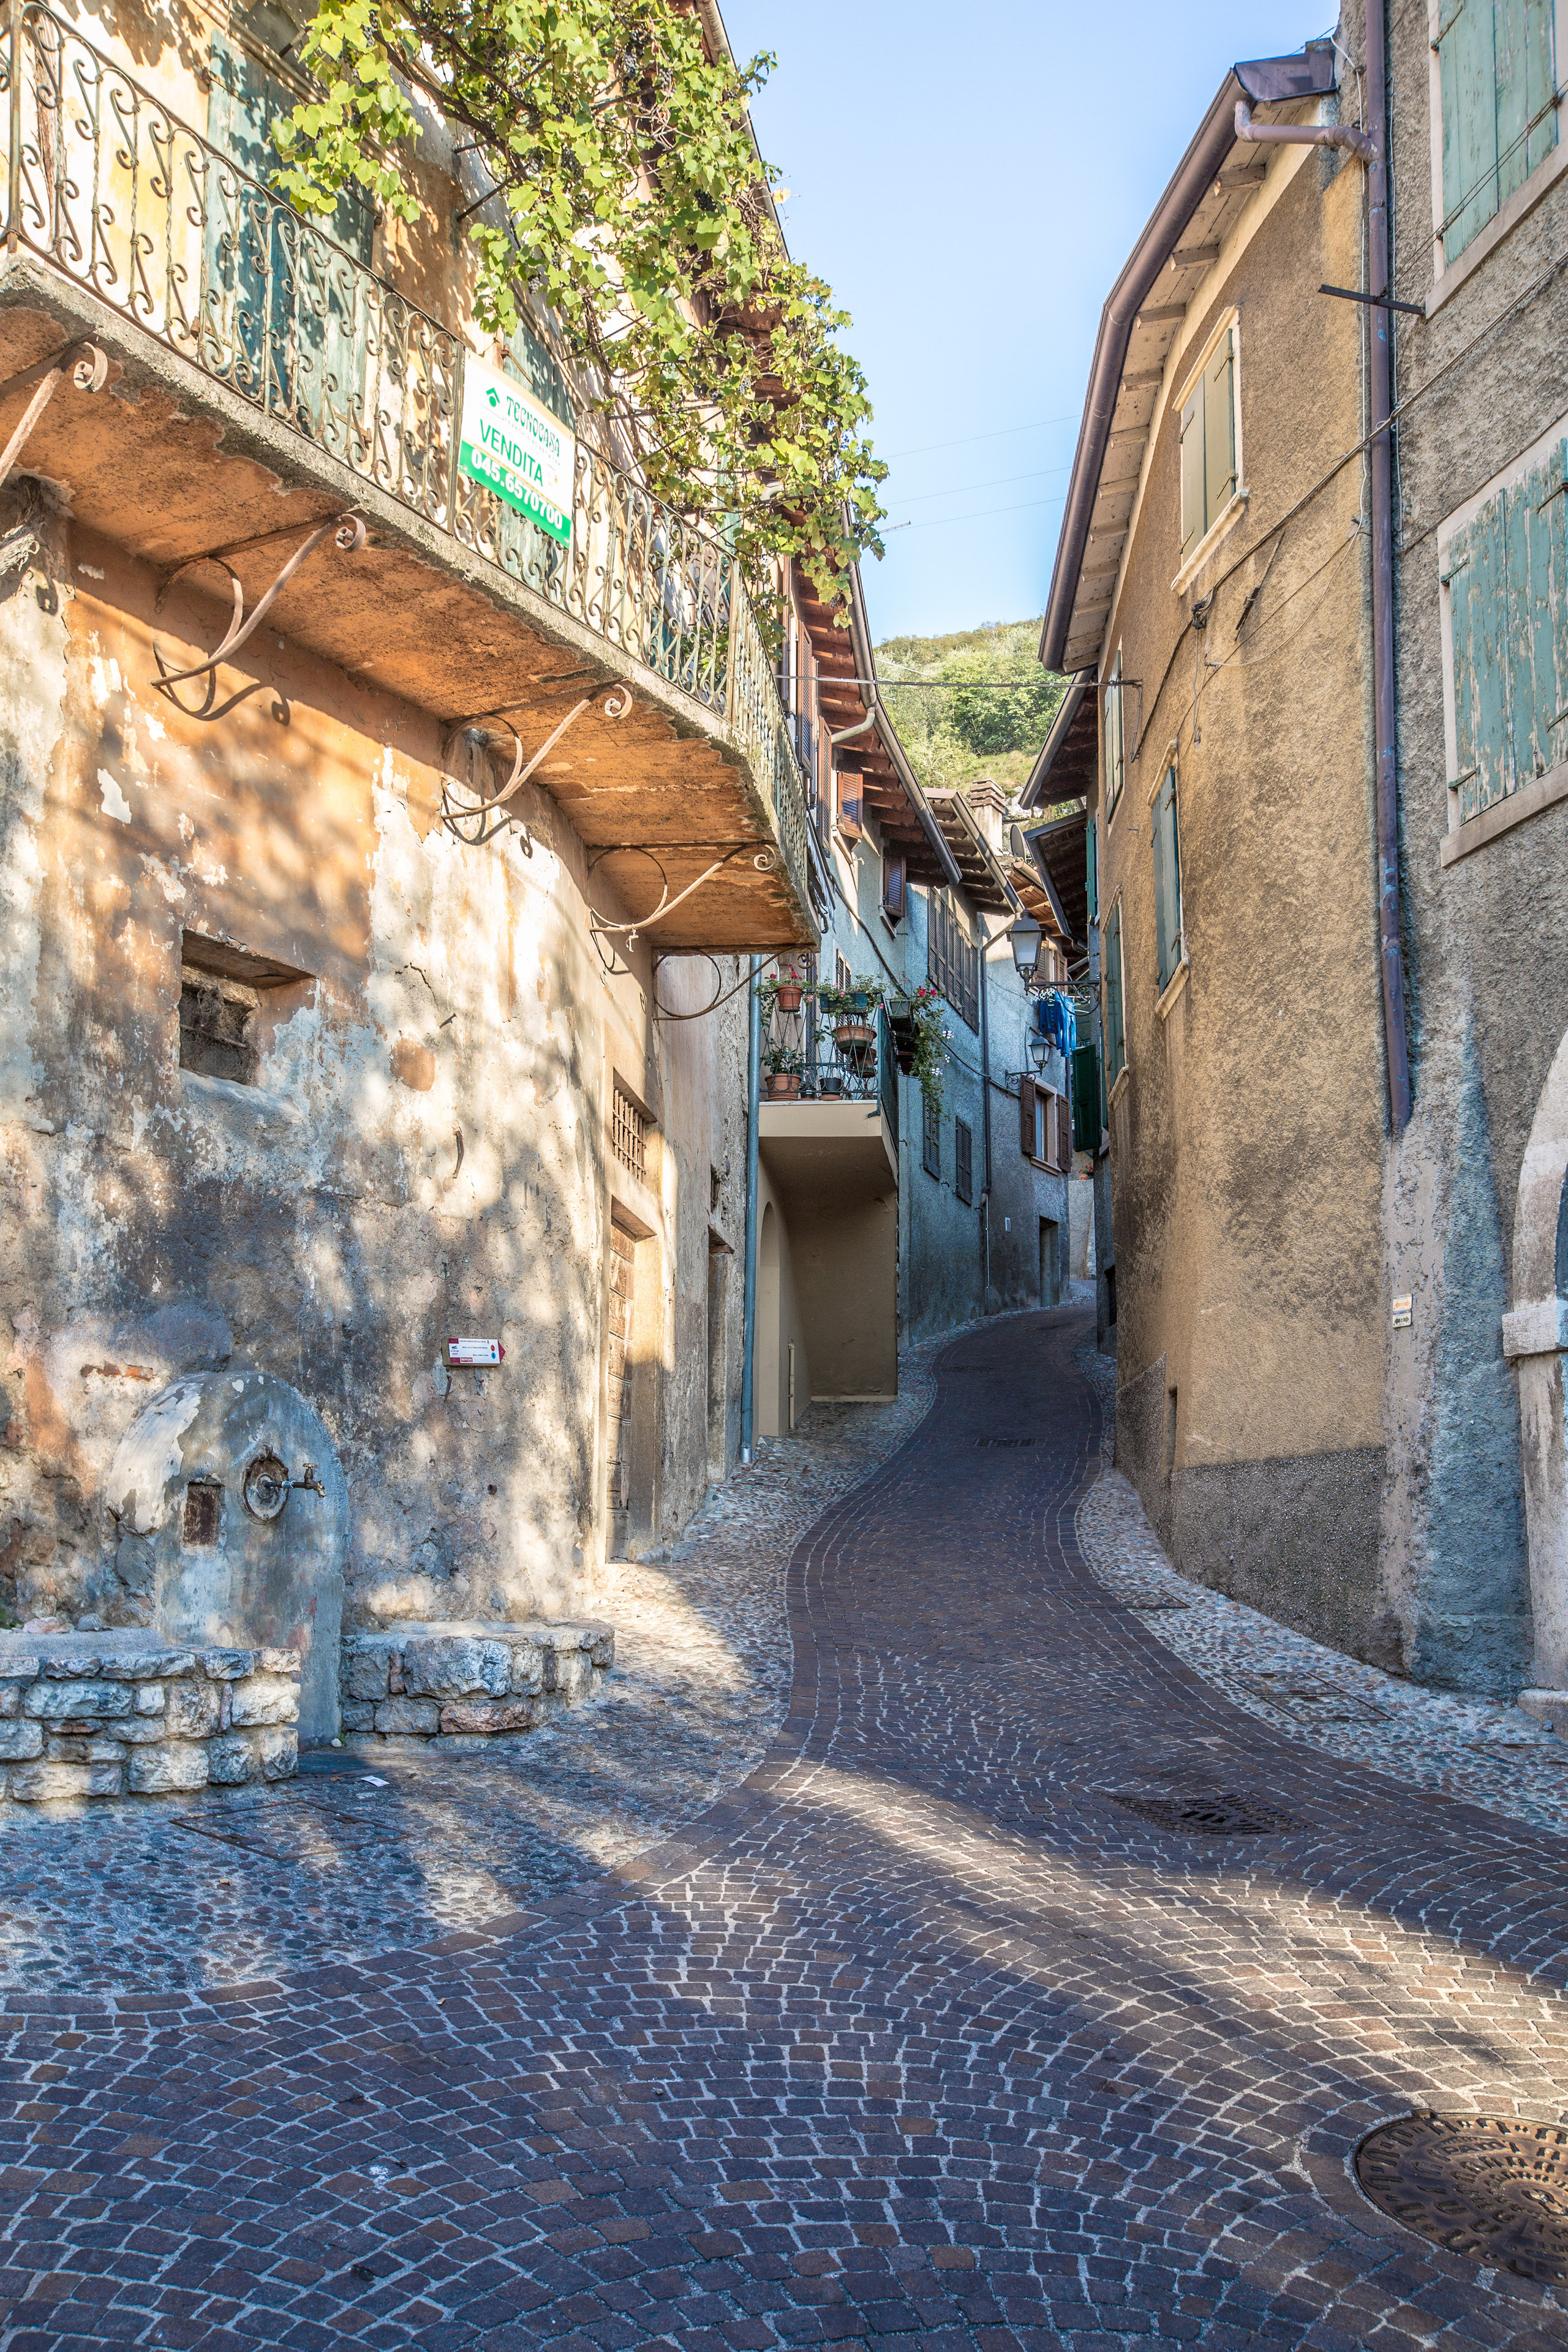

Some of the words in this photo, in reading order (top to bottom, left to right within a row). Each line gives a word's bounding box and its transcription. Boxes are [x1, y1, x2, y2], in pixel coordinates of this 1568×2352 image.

[480, 419, 543, 487] VENDITA
[507, 396, 560, 457] TECNOCASA
[471, 447, 563, 530] 045.6570700
